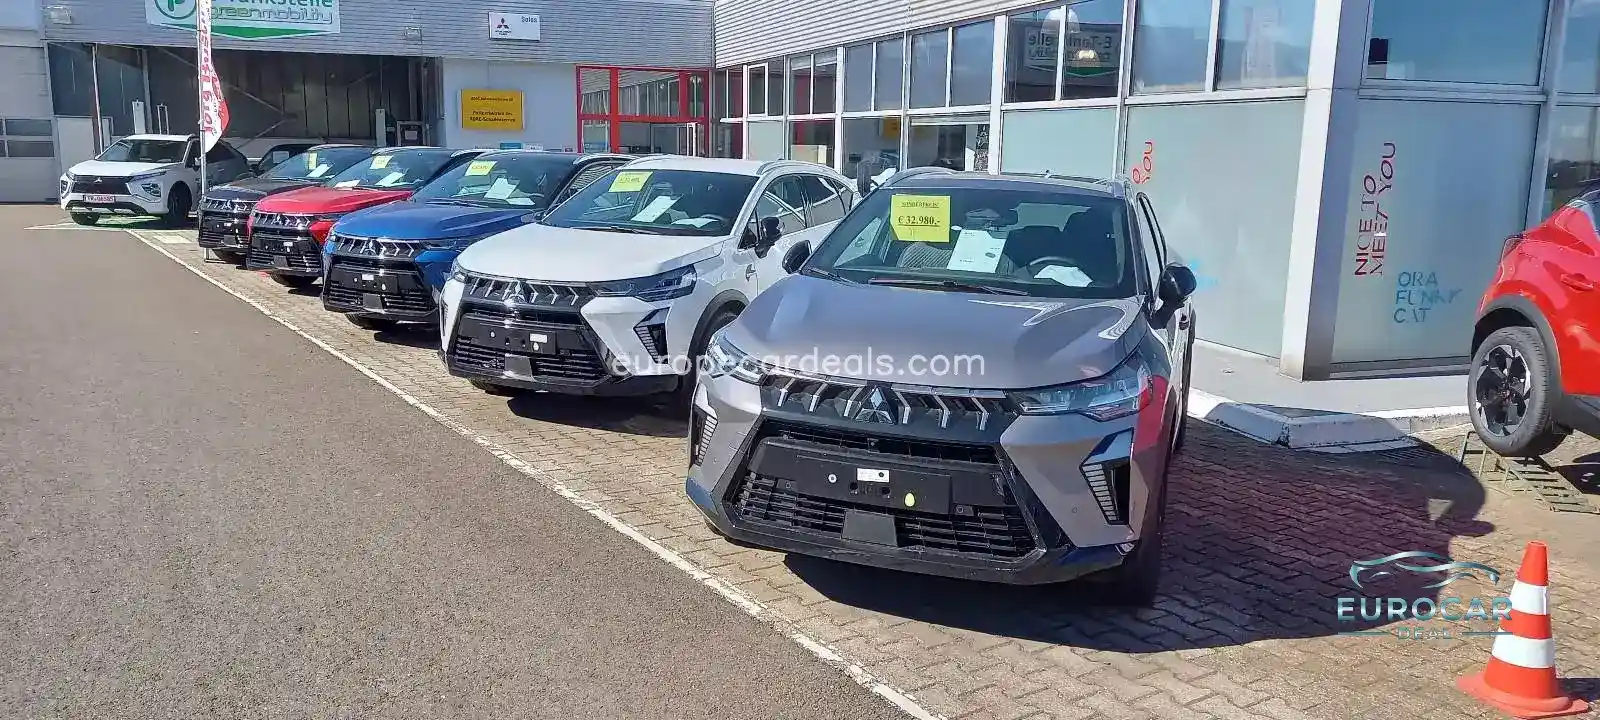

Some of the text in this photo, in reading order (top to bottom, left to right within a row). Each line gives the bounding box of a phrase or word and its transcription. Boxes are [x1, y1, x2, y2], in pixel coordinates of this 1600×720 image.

[521, 16, 538, 24] Sales
[1142, 141, 1153, 184] YOU
[1354, 174, 1377, 276] NICE TO
[1369, 141, 1396, 277] MEET YOU
[1398, 271, 1438, 287] ORA
